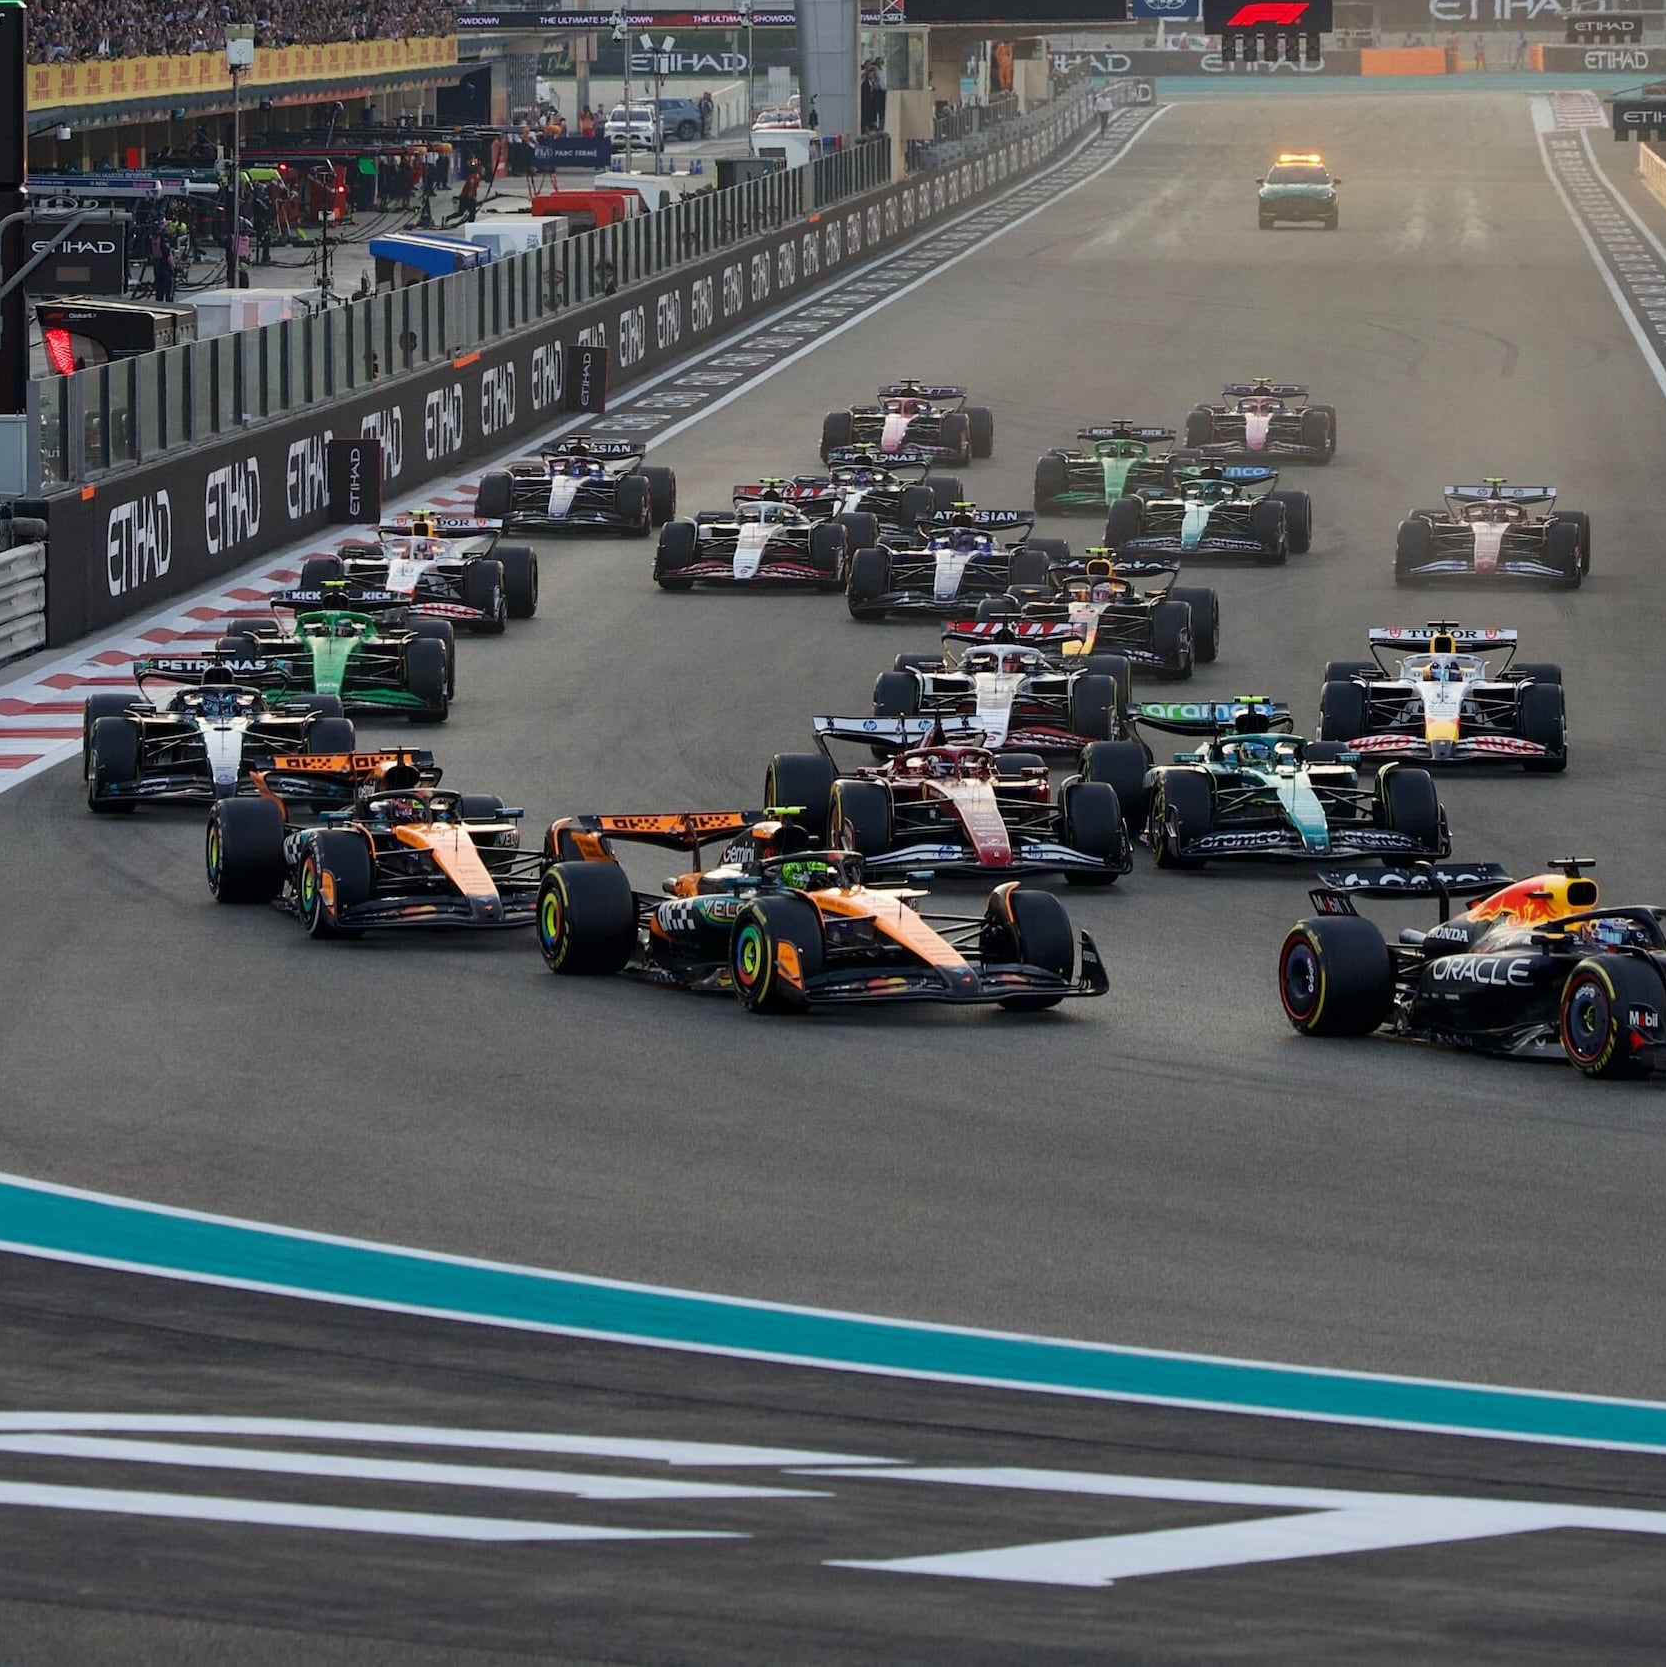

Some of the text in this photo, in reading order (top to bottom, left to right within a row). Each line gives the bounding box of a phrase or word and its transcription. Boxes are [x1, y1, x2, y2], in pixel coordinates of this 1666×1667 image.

[540, 16, 599, 25] THE ULTIMATE
[1574, 21, 1635, 32] ETIHAD
[1585, 51, 1648, 69] ETIHAD
[691, 276, 713, 332] ETIHAD
[657, 289, 681, 349] ETIHAD
[619, 304, 646, 368] ETIHAD
[532, 340, 564, 411] ETIHAD
[580, 352, 592, 407] ETIHAD
[480, 361, 516, 436] ETIHAD
[424, 382, 463, 461] ETIHAD
[349, 447, 361, 516] ETIHAD
[205, 456, 262, 555] ETIHAD
[107, 489, 173, 597] ETIHAD
[291, 590, 323, 601] KICK
[362, 590, 392, 601] KICK
[423, 602, 478, 620] HUGO
[1348, 734, 1411, 752] HUGO
[1474, 736, 1539, 755] HUGO
[613, 818, 662, 830] OKX
[1200, 831, 1283, 848] aramco
[723, 842, 755, 863] Gemini
[658, 899, 696, 931] OKX
[1433, 958, 1531, 985] ORACLE
[1629, 1010, 1659, 1029] Mobil
